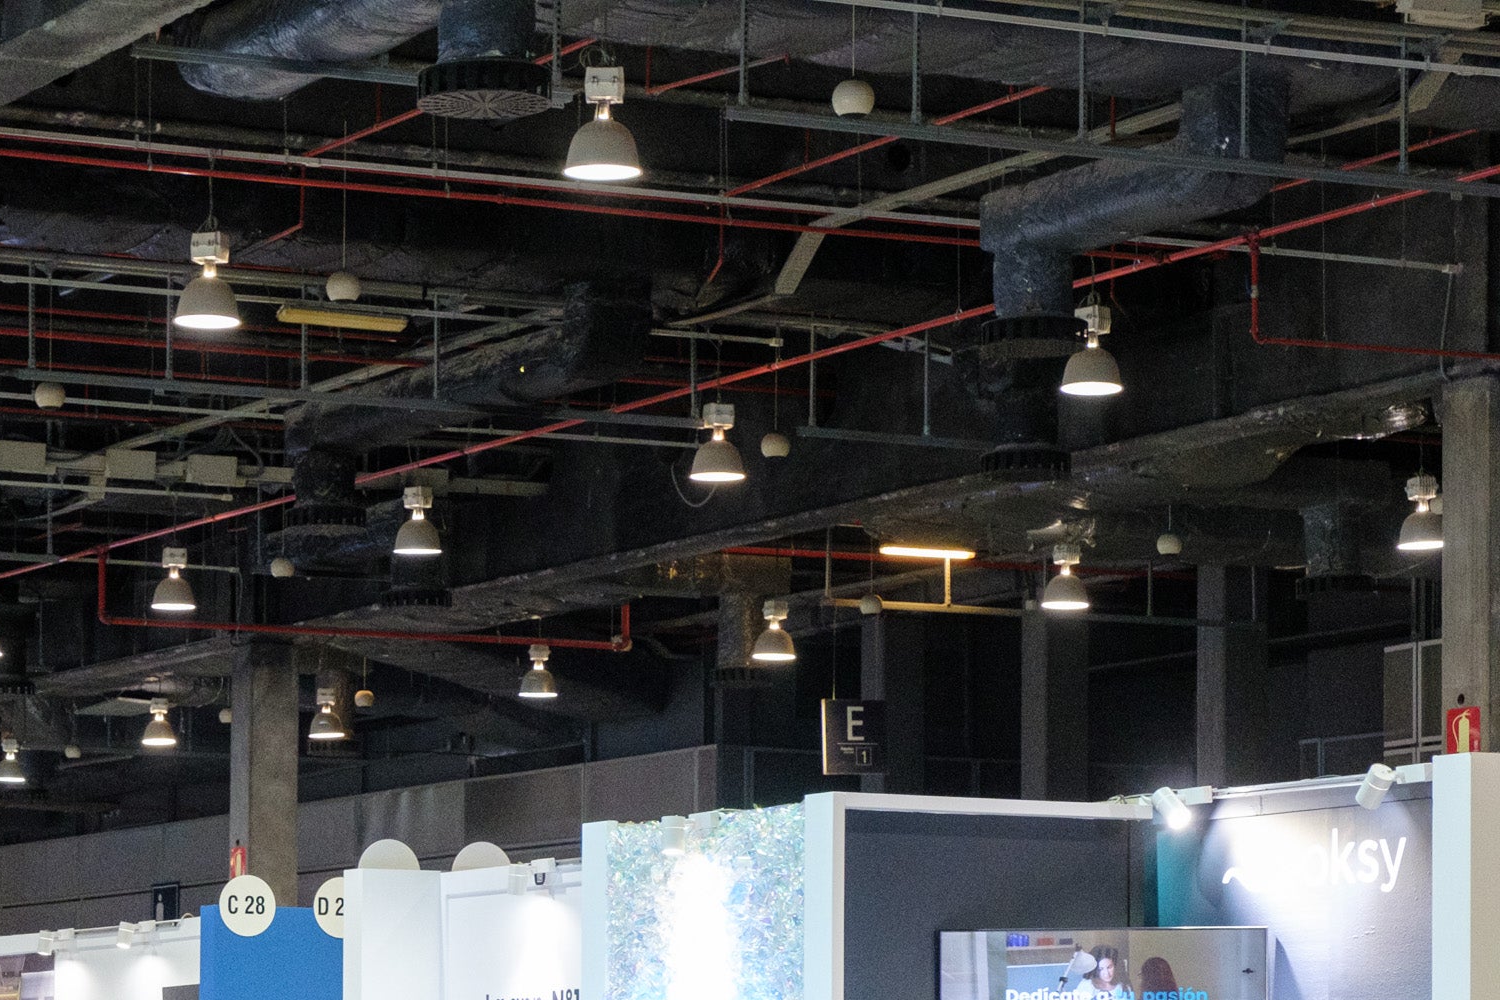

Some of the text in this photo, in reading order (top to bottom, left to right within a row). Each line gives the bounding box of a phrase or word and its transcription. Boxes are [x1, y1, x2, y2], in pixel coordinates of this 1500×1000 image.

[846, 705, 865, 741] E
[861, 750, 868, 764] 1
[228, 895, 266, 915] C 28
[318, 897, 345, 916] D 2
